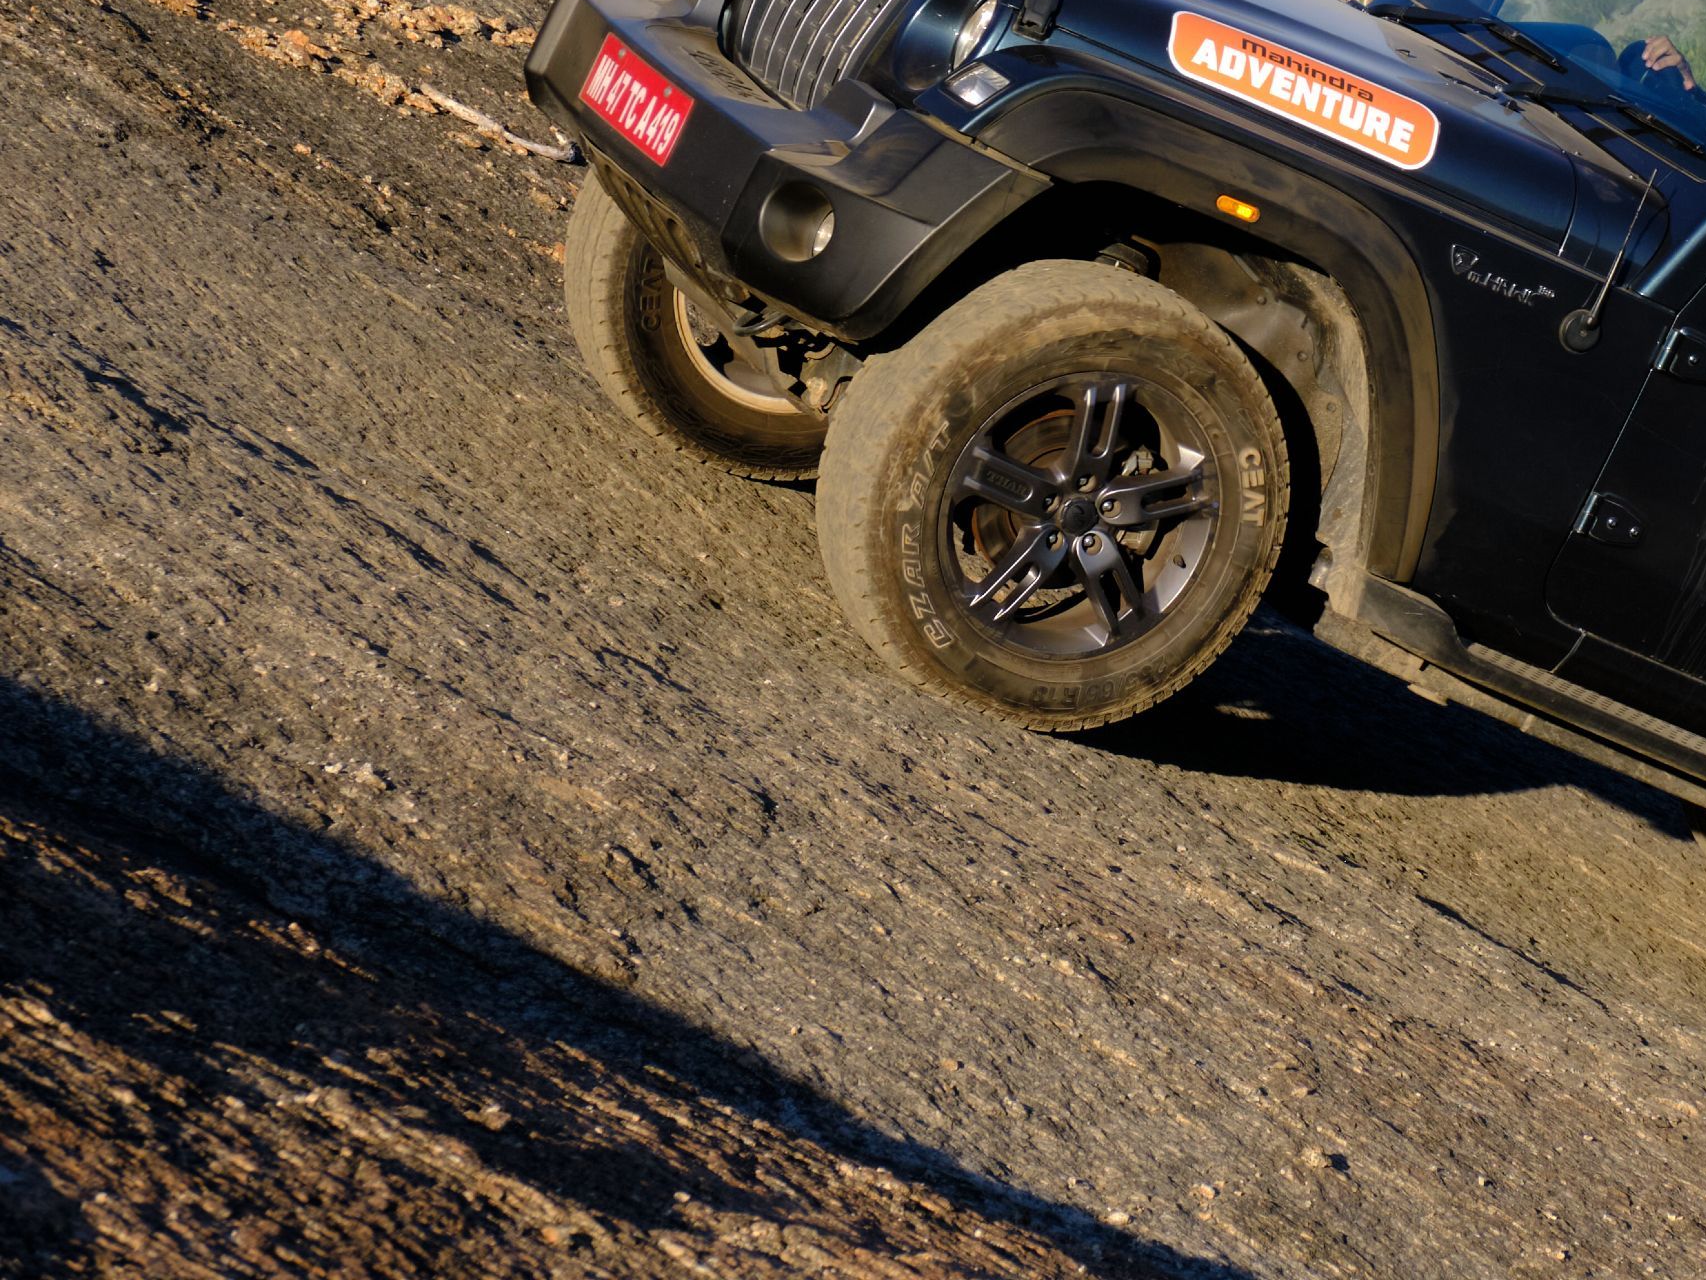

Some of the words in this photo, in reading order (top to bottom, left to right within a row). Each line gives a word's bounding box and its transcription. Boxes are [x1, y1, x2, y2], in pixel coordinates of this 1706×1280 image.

[586, 54, 619, 105] MH
[605, 70, 632, 115] 47
[618, 80, 647, 130] TC
[1191, 38, 1415, 153] ADVENTURE
[1238, 446, 1267, 527] CEAT
